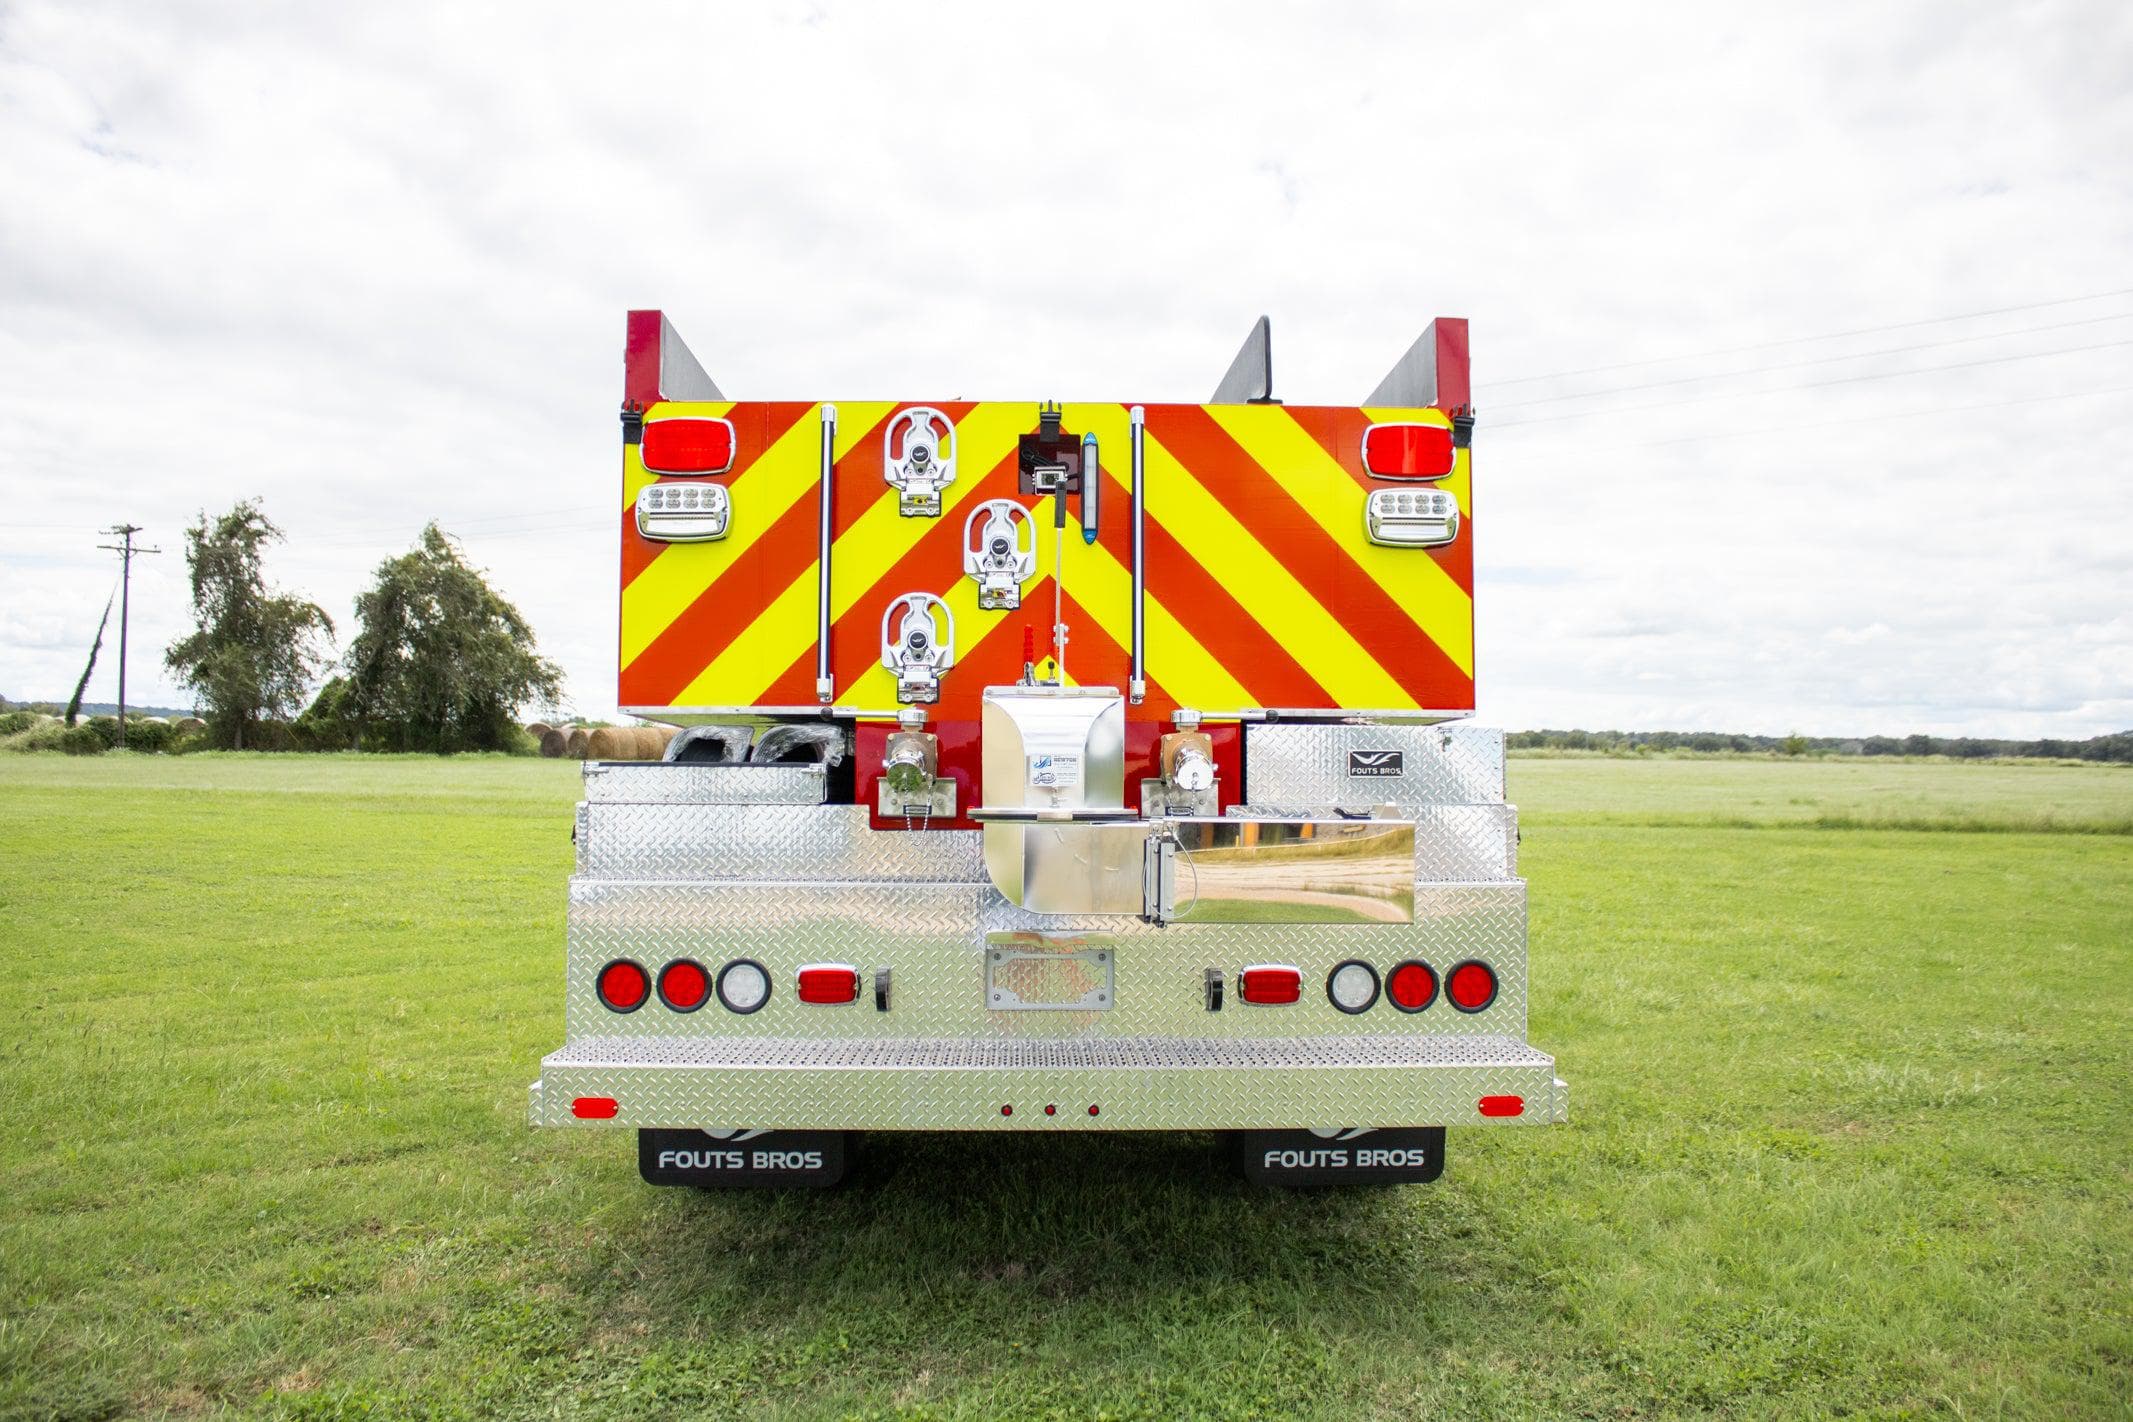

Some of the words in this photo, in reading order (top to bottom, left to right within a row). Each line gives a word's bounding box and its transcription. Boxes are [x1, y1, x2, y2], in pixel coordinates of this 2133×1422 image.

[1380, 767, 1402, 775] BROS
[659, 1151, 744, 1169] FOUTS
[752, 1151, 823, 1169] BROS
[1264, 1150, 1348, 1168] FOUTS
[1356, 1150, 1424, 1167] BROS
